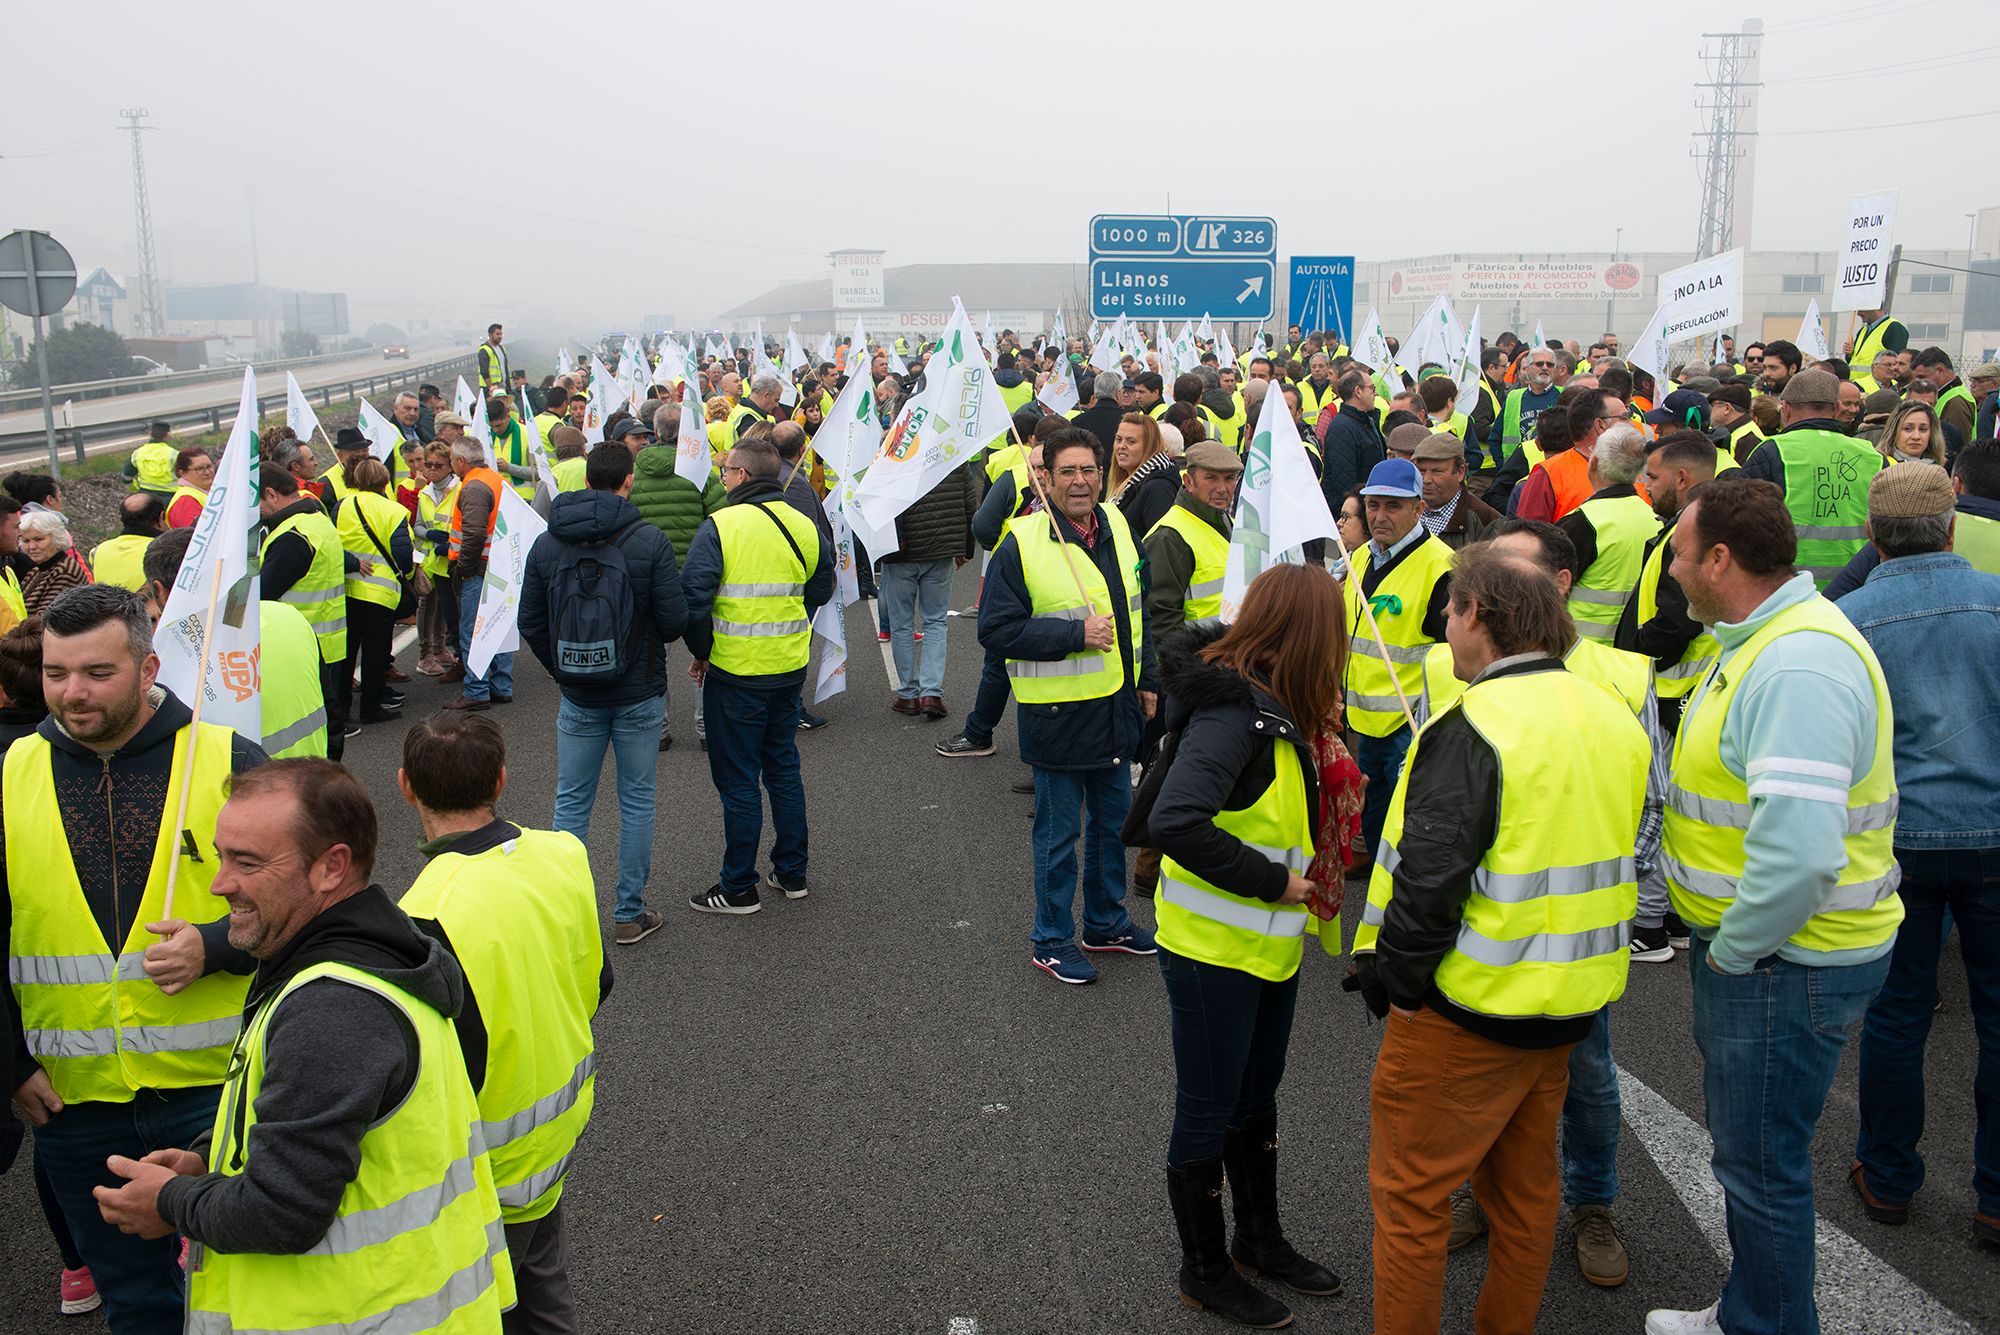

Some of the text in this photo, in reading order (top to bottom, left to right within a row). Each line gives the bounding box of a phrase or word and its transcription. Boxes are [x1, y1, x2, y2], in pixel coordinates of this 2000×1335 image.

[1853, 213, 1884, 229] POR UN
[1101, 228, 1170, 242] 1000 m
[1232, 230, 1265, 244] 326
[1850, 237, 1879, 253] PRECIO
[838, 256, 881, 265] DESGUACE
[1518, 263, 1534, 271] de
[1539, 263, 1593, 271] Muebles
[851, 268, 870, 277] VEGA
[1295, 262, 1349, 276] AUTOVÍA
[1462, 272, 1506, 280] OFERTA
[1509, 272, 1525, 280] DE
[1842, 262, 1878, 284] JUSTO
[1101, 271, 1170, 288] Llanos
[1470, 281, 1588, 290] Muebles AL COSTO
[839, 288, 866, 296] GRANDE
[1673, 274, 1723, 301] ¡NO A LA
[1101, 294, 1186, 306] del Sotillo
[1461, 291, 1478, 299] Gran
[1479, 291, 1508, 299] variedad
[1555, 291, 1592, 299] Comedores
[1594, 293, 1599, 301] y
[900, 313, 976, 327] DESGUE
[894, 407, 928, 459] COAG
[1817, 466, 1830, 482] PI
[1816, 484, 1850, 500] CUA
[1815, 503, 1838, 518] LIA
[562, 648, 610, 665] MUNICH
[226, 652, 252, 703] UPA
